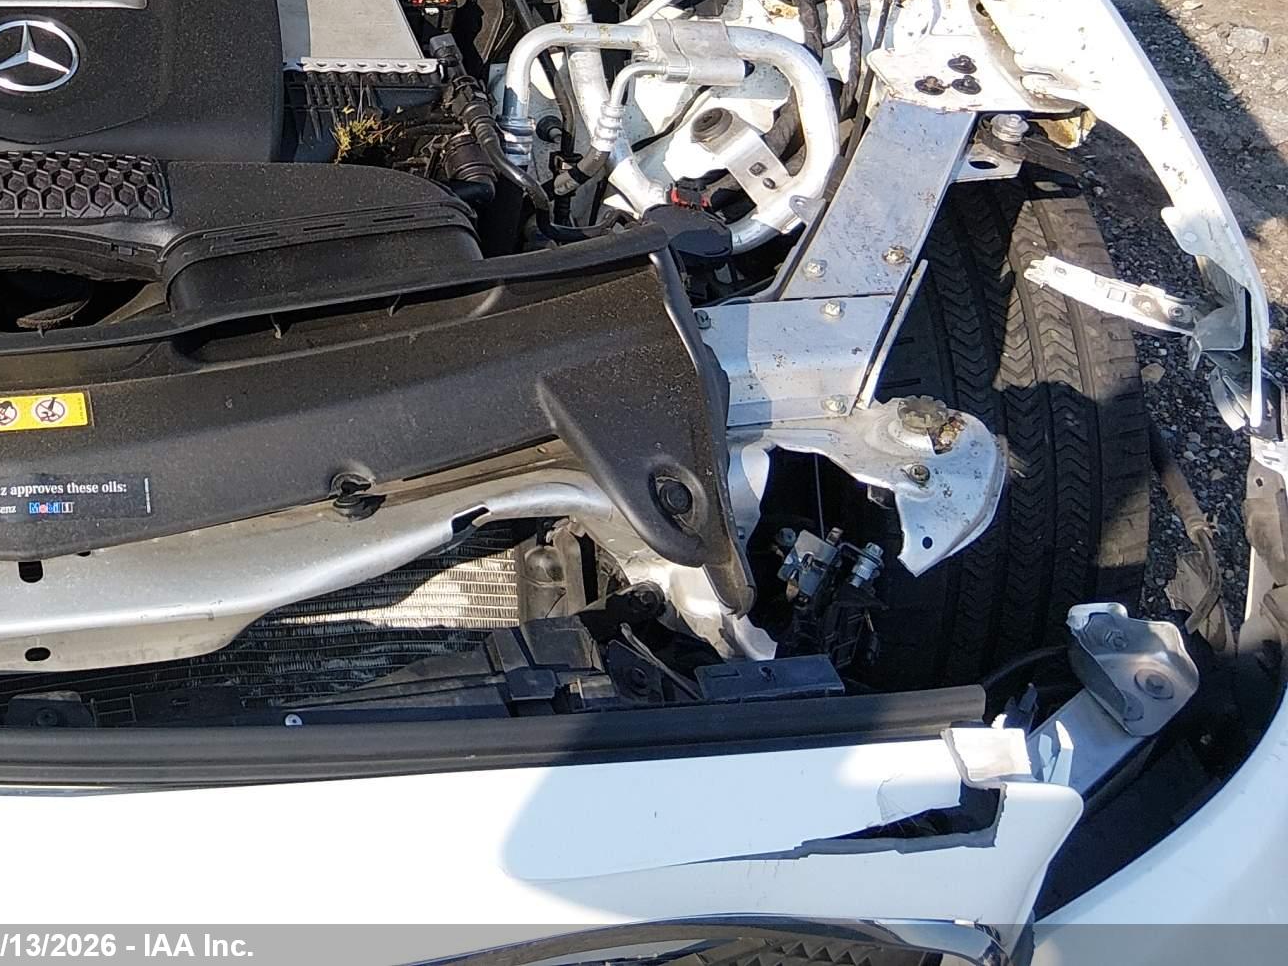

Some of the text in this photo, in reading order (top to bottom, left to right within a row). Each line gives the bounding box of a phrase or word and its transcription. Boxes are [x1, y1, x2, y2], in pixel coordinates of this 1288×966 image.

[10, 484, 64, 498] approves
[66, 481, 99, 494] these
[101, 480, 128, 494] oils:
[29, 501, 61, 514] Mobil
